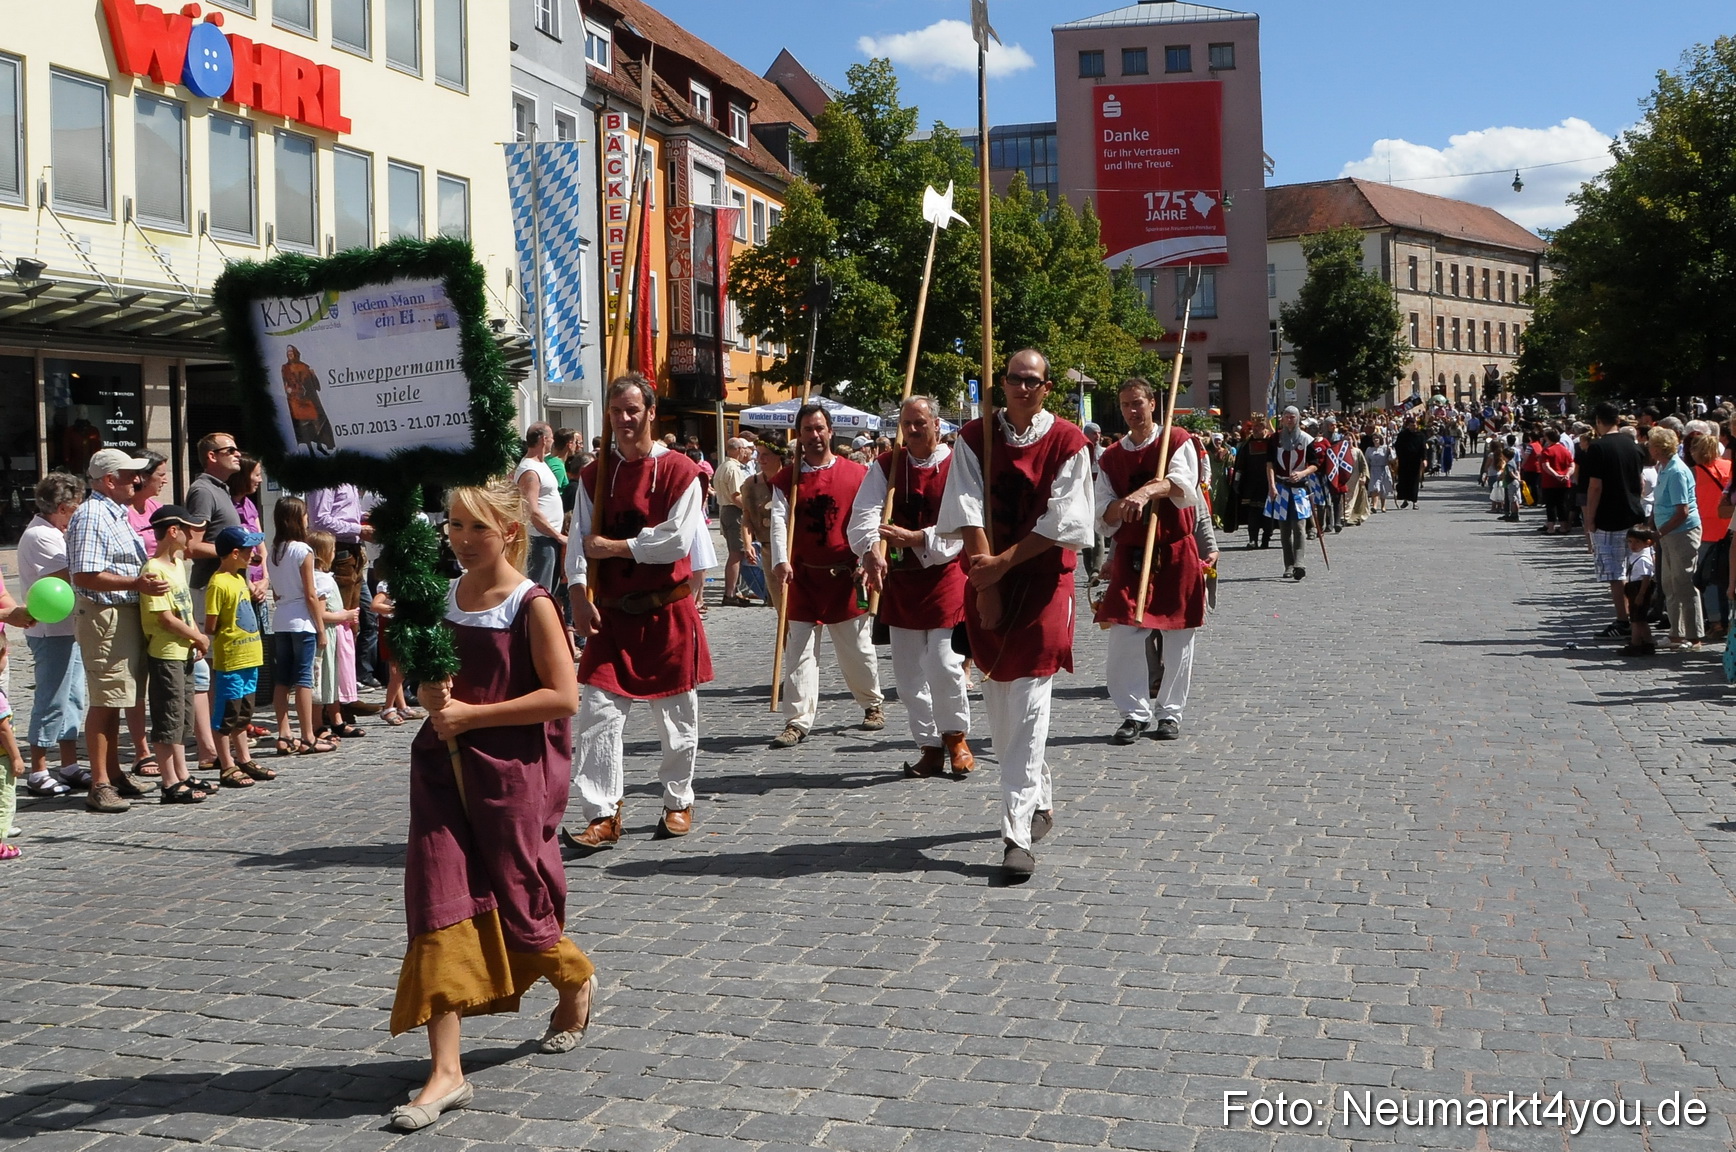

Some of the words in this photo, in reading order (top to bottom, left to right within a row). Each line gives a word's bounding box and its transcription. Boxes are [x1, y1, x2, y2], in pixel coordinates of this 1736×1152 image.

[103, 0, 351, 135] WÖHRL
[1103, 128, 1150, 142] Danke
[1103, 149, 1117, 157] für
[1119, 148, 1132, 157] Ihr
[1133, 147, 1180, 157] Vertrauen
[1104, 161, 1122, 170] und
[1124, 160, 1143, 169] Ihre
[1145, 159, 1174, 169] Treue.
[607, 115, 624, 288] BÄCKEREI
[1143, 191, 1187, 210] 175
[1145, 209, 1187, 221] JAHRE
[261, 295, 330, 328] KASTL
[352, 298, 388, 315] Jedem
[390, 294, 425, 307] Mann
[375, 312, 395, 328] ein
[376, 384, 420, 407] spiele
[335, 419, 398, 437] 05.07.2013
[407, 411, 471, 430] 21.07.201
[748, 413, 772, 421] Winkler
[773, 413, 787, 421] Bräu
[837, 414, 851, 423] Bräu
